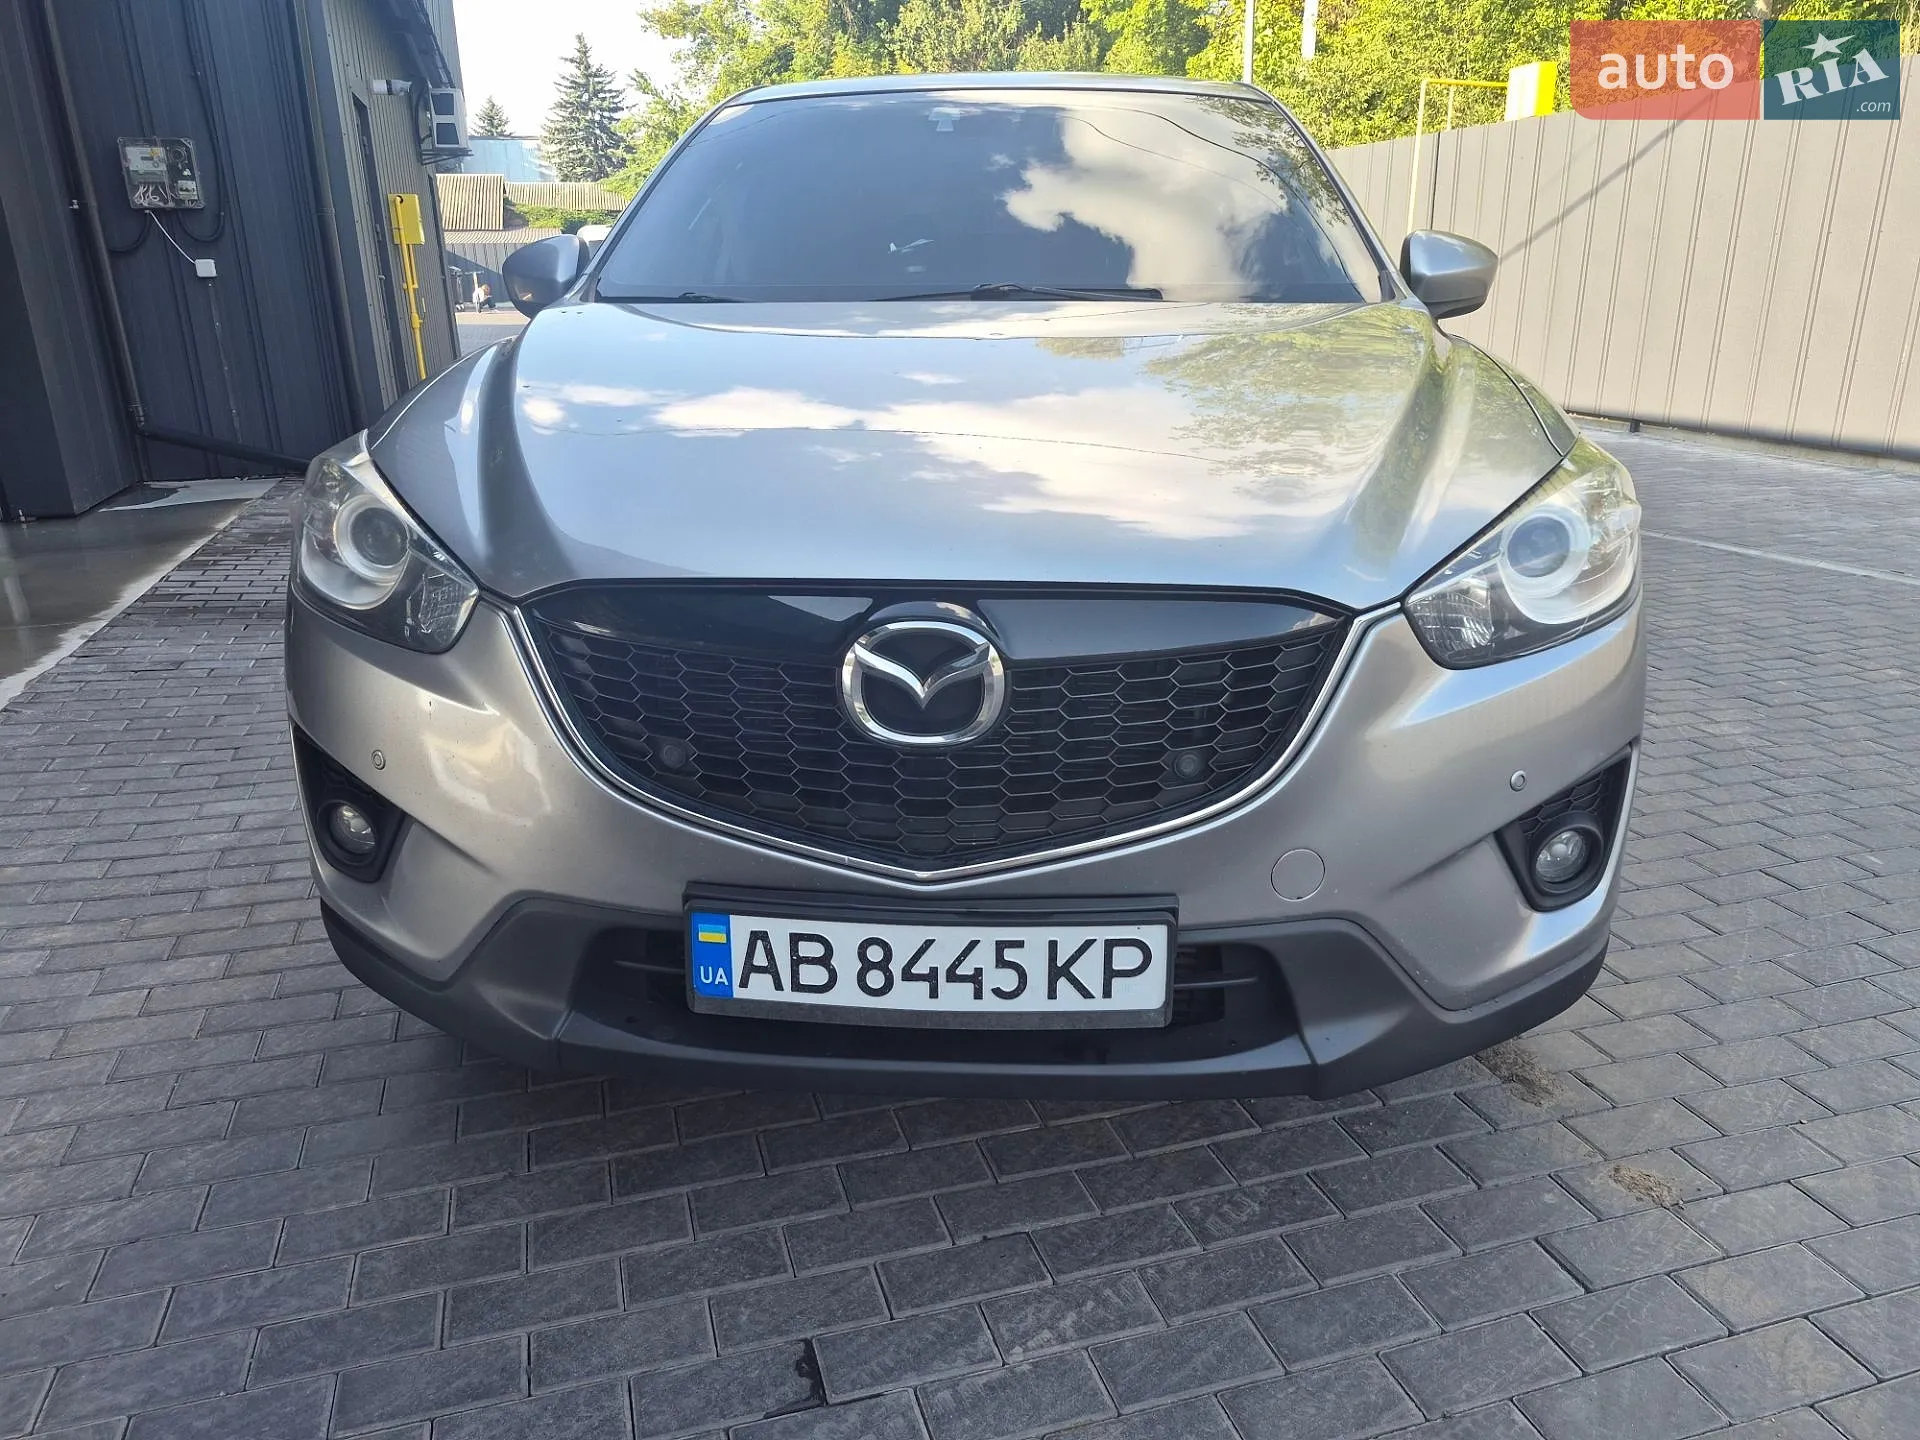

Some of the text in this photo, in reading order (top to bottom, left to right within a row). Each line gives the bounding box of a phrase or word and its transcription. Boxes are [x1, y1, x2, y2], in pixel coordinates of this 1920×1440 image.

[700, 965, 729, 986] UA
[738, 930, 1153, 1001] AB 8445 KP
